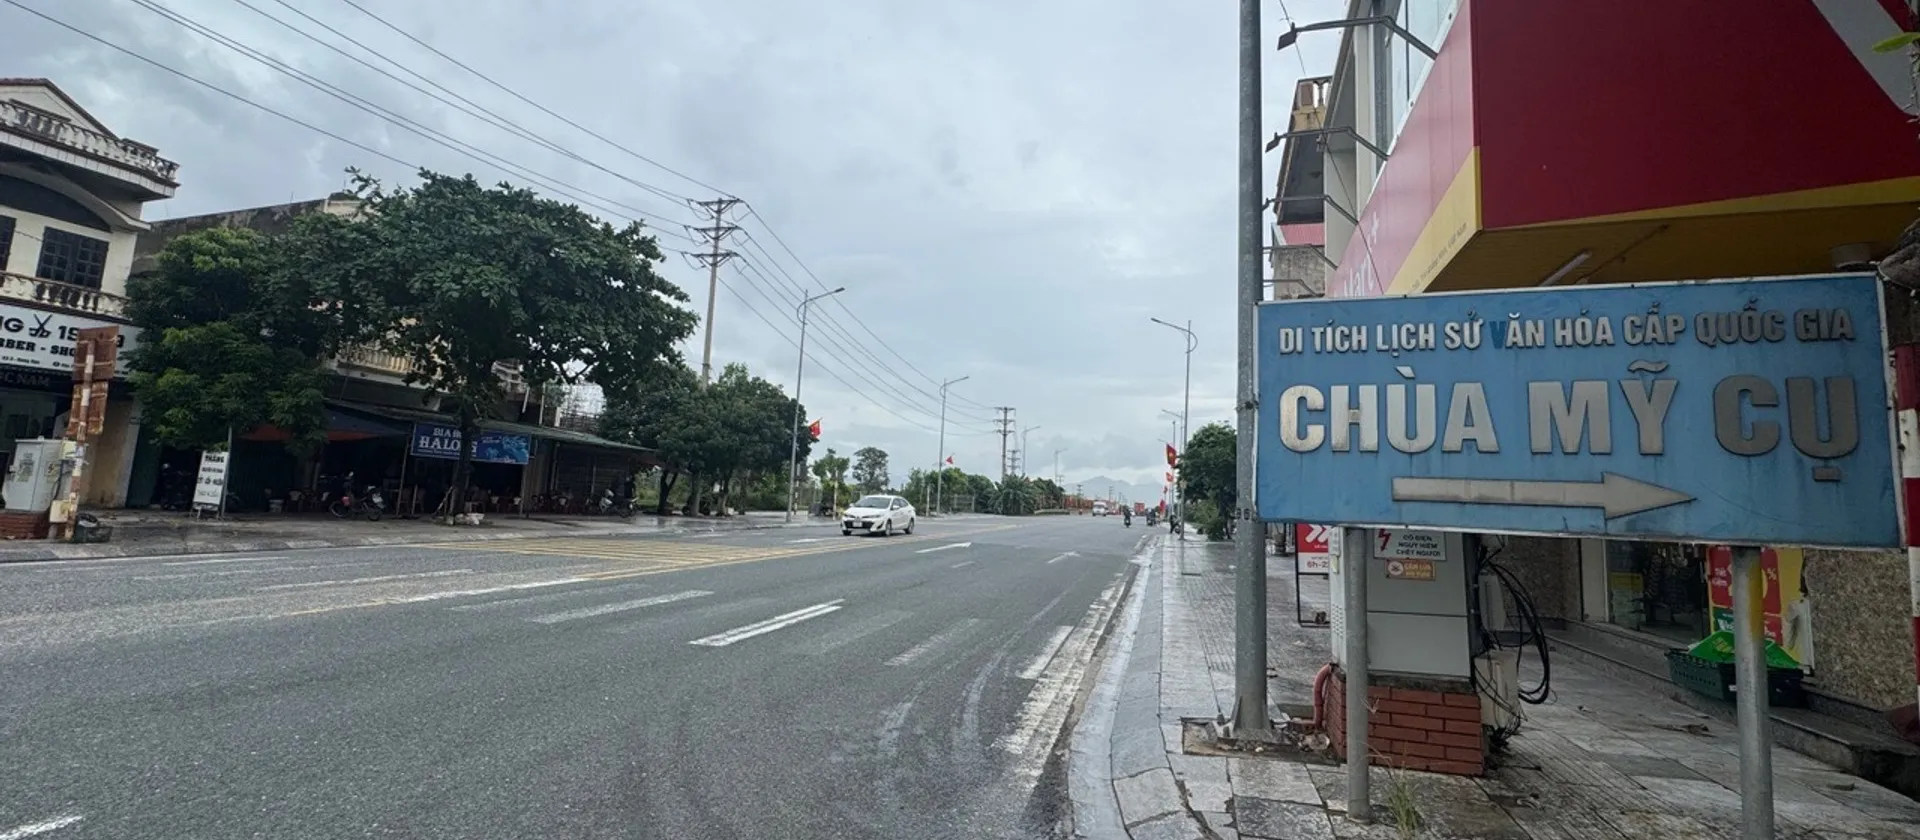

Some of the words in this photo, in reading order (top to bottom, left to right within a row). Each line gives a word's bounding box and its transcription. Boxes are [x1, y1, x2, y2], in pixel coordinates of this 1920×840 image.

[0, 316, 25, 334] G
[1279, 327, 1304, 355] DI
[1311, 319, 1368, 354] TÍCH
[1376, 322, 1435, 357] LỊCH
[1444, 307, 1484, 350] SỬ
[1490, 312, 1546, 350] VĂN
[1554, 308, 1615, 347] HÓA
[1622, 302, 1686, 346] CẤP
[1694, 297, 1786, 348] QUỐC
[1794, 307, 1856, 342] GIA
[1279, 365, 1500, 454] CHÙA
[1528, 359, 1679, 456] MỸ
[1713, 374, 1860, 482] CỤ
